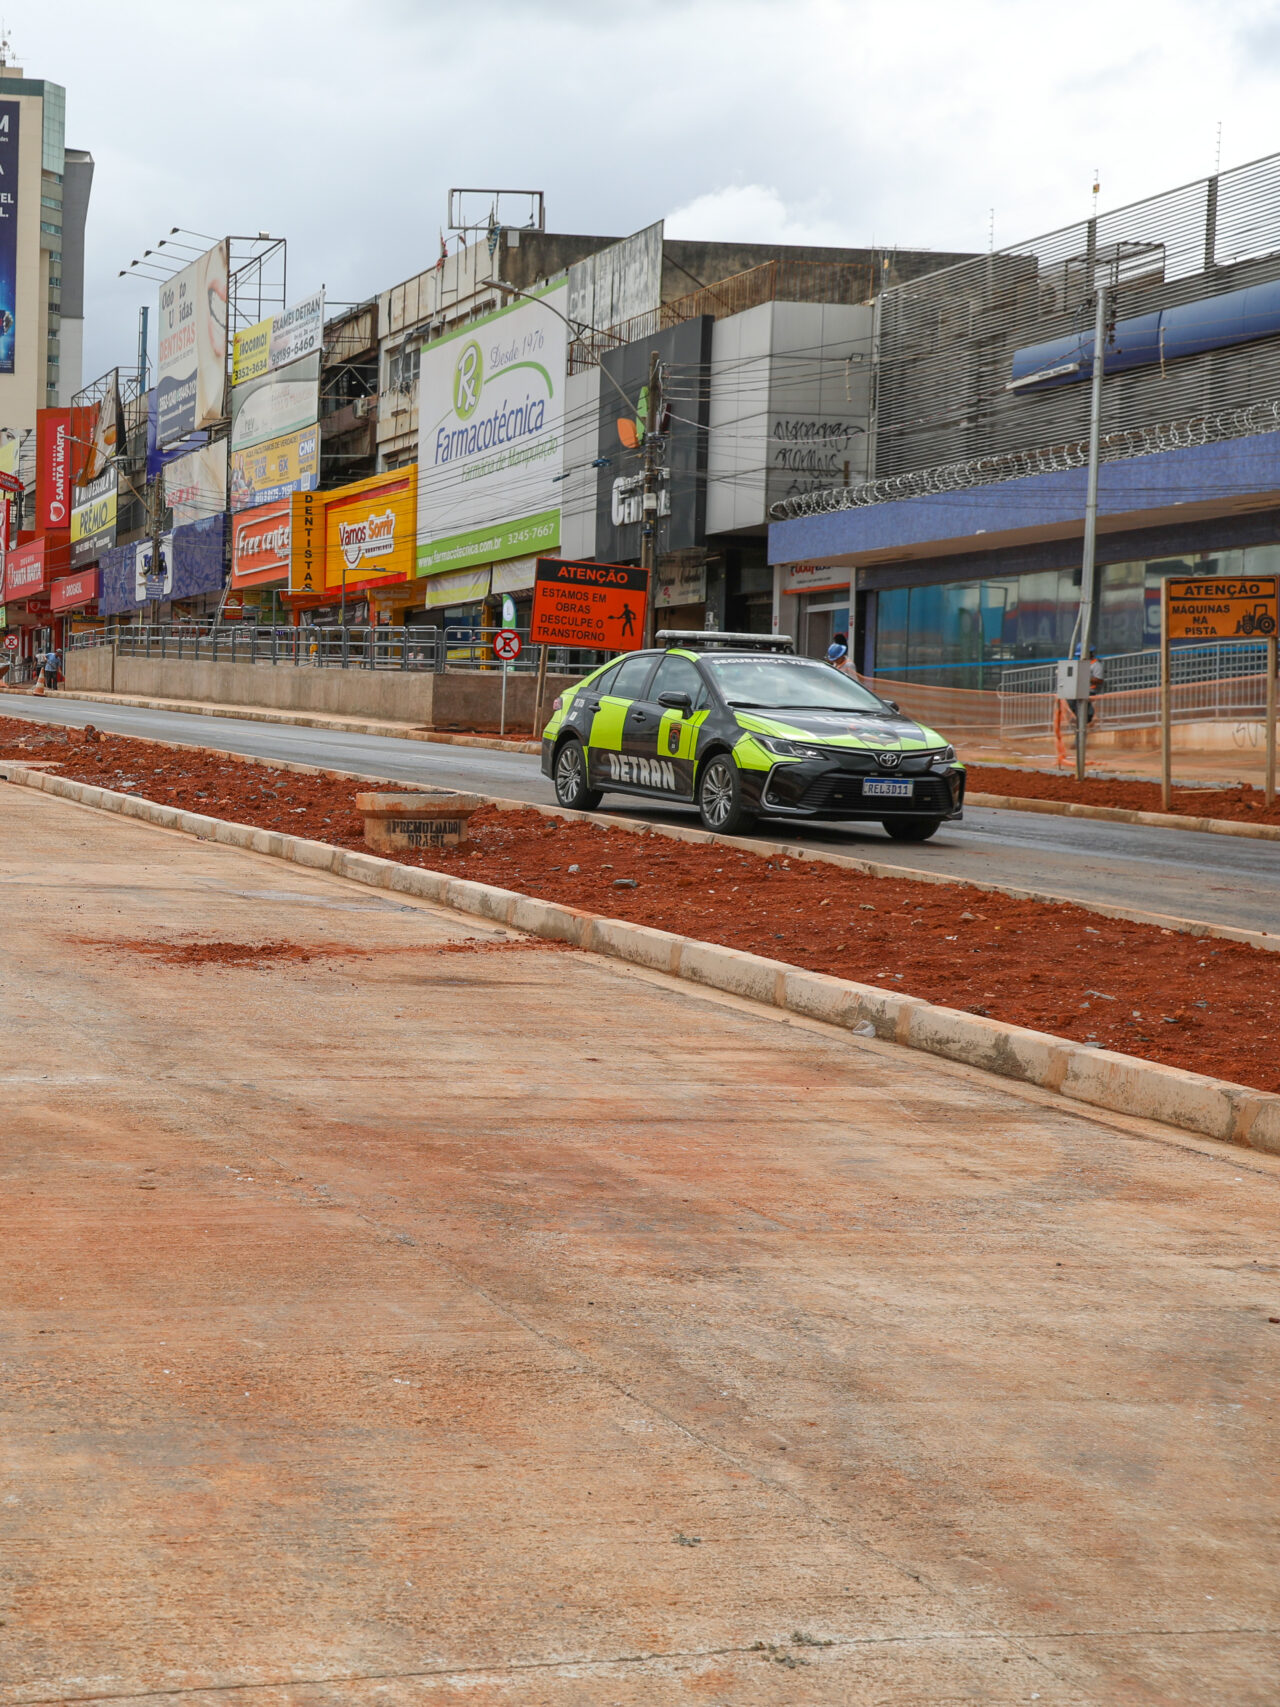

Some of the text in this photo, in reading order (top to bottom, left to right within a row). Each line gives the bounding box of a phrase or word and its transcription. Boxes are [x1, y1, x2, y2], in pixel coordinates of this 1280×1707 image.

[159, 322, 196, 362] DENTISTAS
[490, 340, 519, 369] Desde
[435, 393, 545, 464] Farmacotécnica
[299, 439, 315, 457] CNH
[56, 425, 65, 500] SANTA MARTA
[339, 515, 394, 547] Vamos Sorrir
[507, 523, 555, 545] 3245-7667
[304, 494, 314, 590] DENTISTAS
[557, 566, 629, 584] ATENÇÃO
[542, 588, 607, 603] ESTAMOS EM
[1184, 582, 1261, 598] ATENÇÃO
[556, 602, 591, 614] OBRAS
[1172, 603, 1231, 615] MÁQUINAS
[540, 614, 604, 629] DESCULPE O
[1193, 616, 1208, 625] NA
[537, 626, 606, 642] TRANSTORNO
[1185, 626, 1218, 636] PISTA
[712, 657, 786, 666] SEGURANÇA
[608, 752, 676, 791] DETRAN
[868, 784, 908, 795] REL3D11
